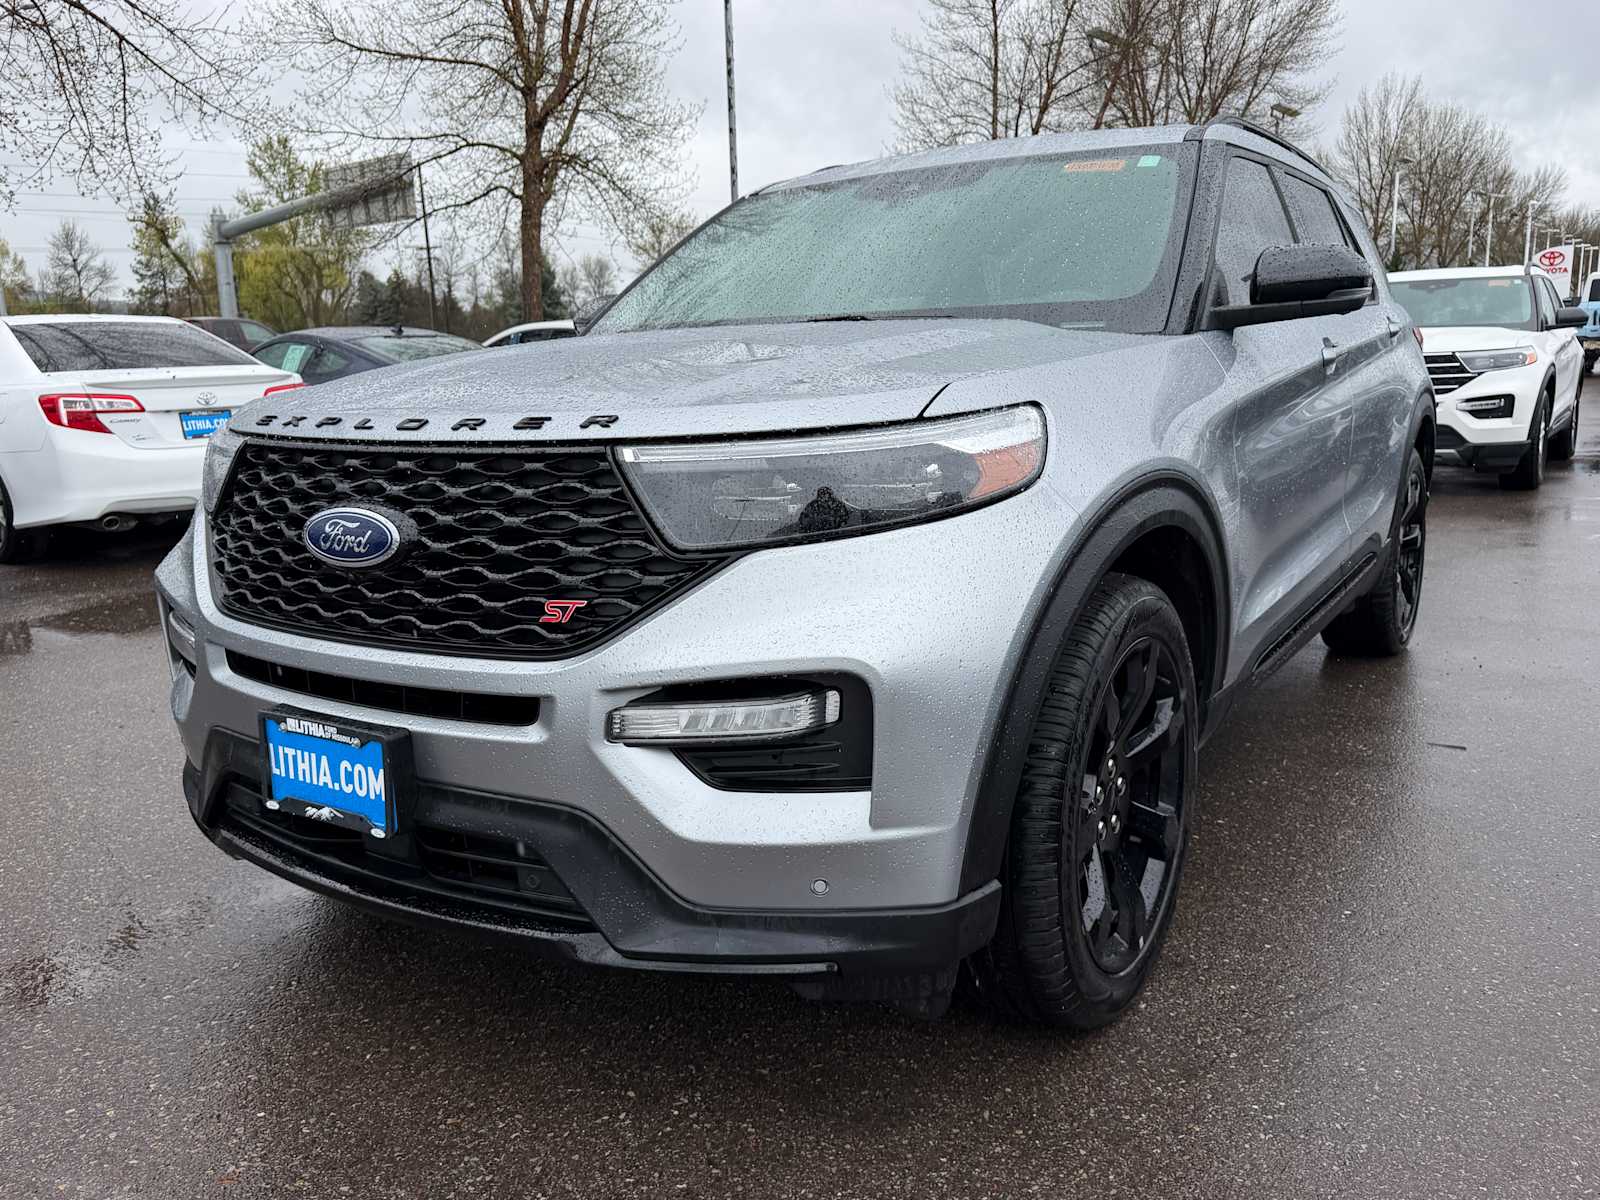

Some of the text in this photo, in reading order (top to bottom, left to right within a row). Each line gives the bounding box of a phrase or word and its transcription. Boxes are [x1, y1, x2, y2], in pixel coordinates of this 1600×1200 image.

[256, 415, 619, 431] EXPLORER
[320, 519, 371, 554] Ford
[539, 600, 587, 624] ST
[269, 743, 385, 801] LITHIA.COM
